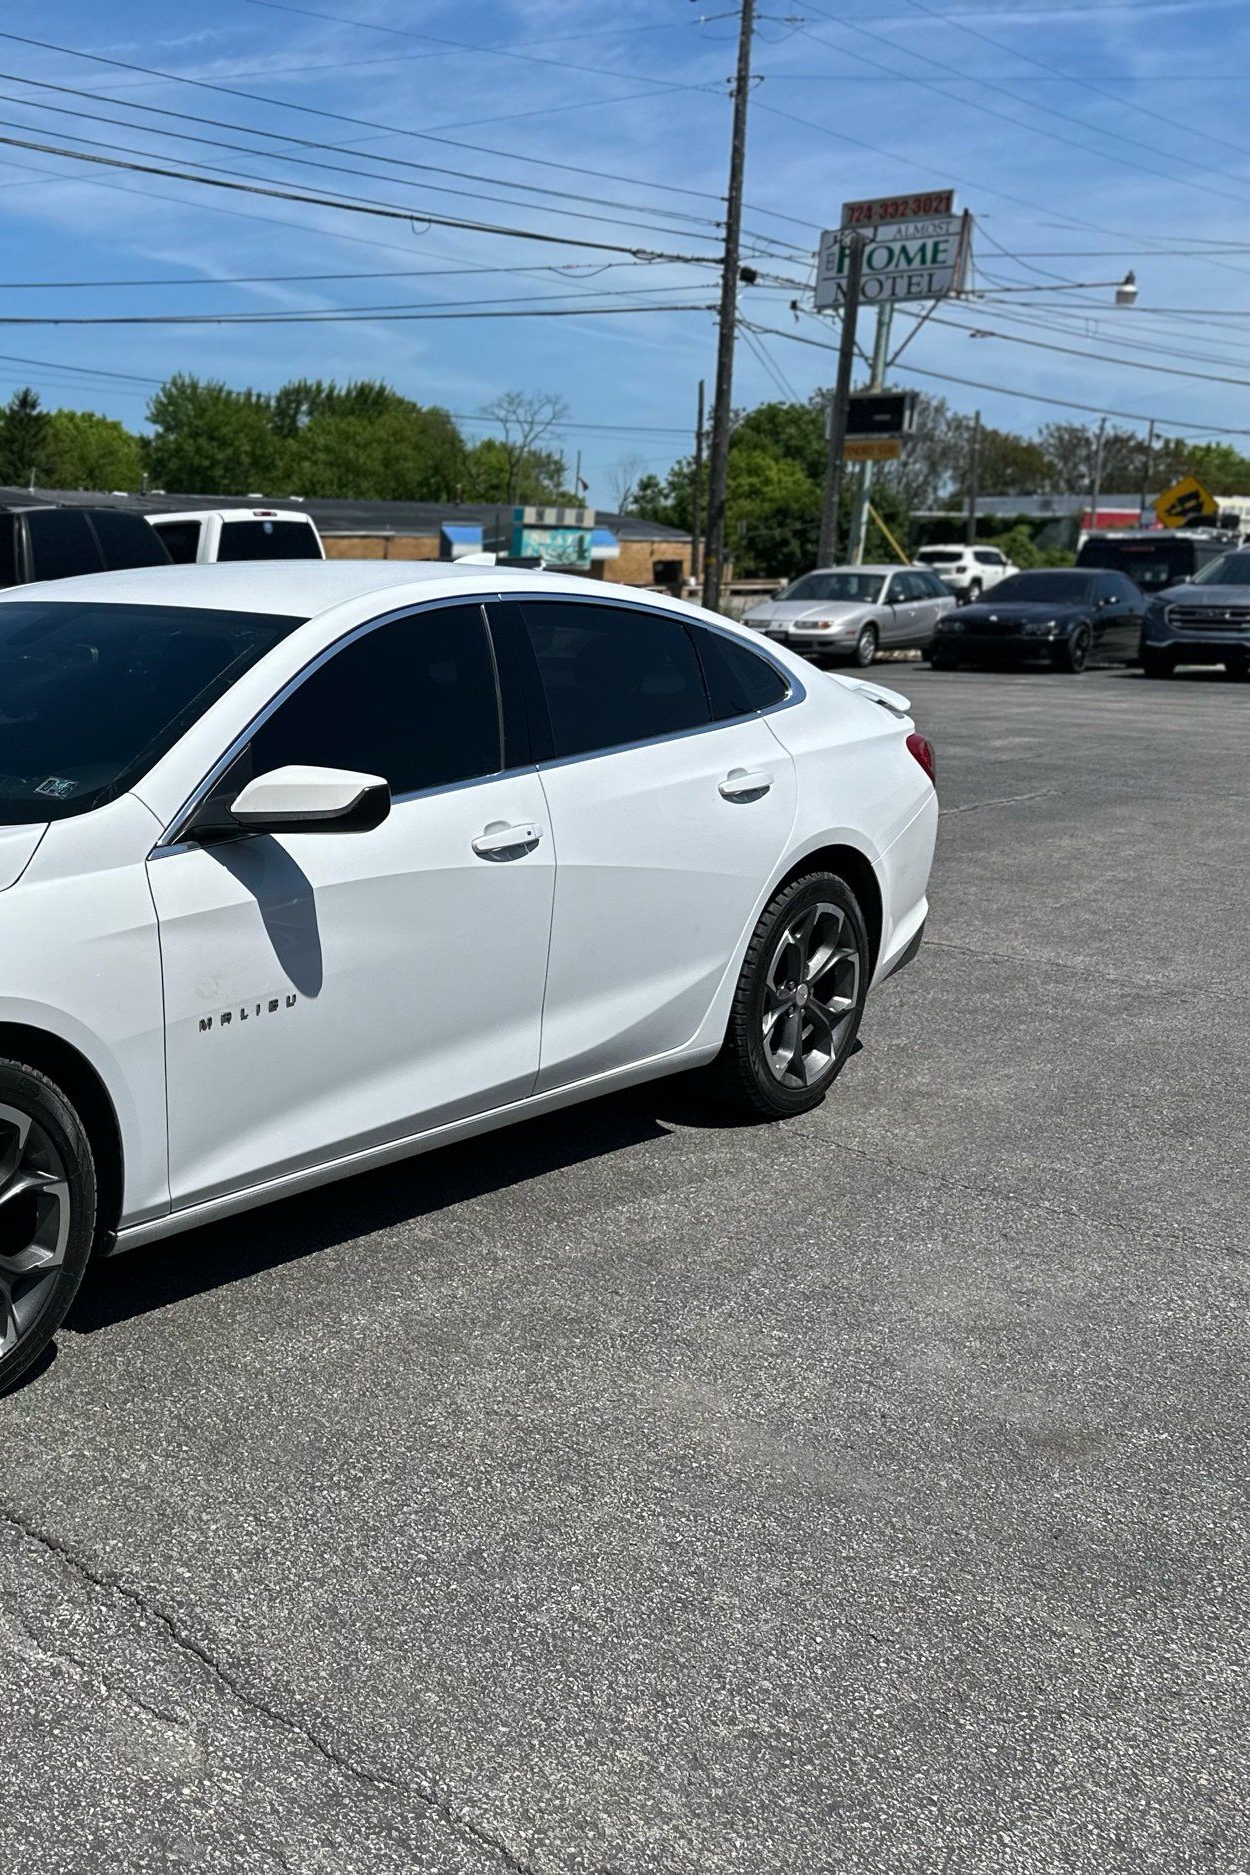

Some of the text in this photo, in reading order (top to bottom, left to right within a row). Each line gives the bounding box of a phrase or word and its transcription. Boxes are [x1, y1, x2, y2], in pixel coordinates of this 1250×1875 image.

[847, 204, 873, 222] 724
[893, 221, 952, 239] ALMOST
[199, 994, 297, 1032] MALIBU
